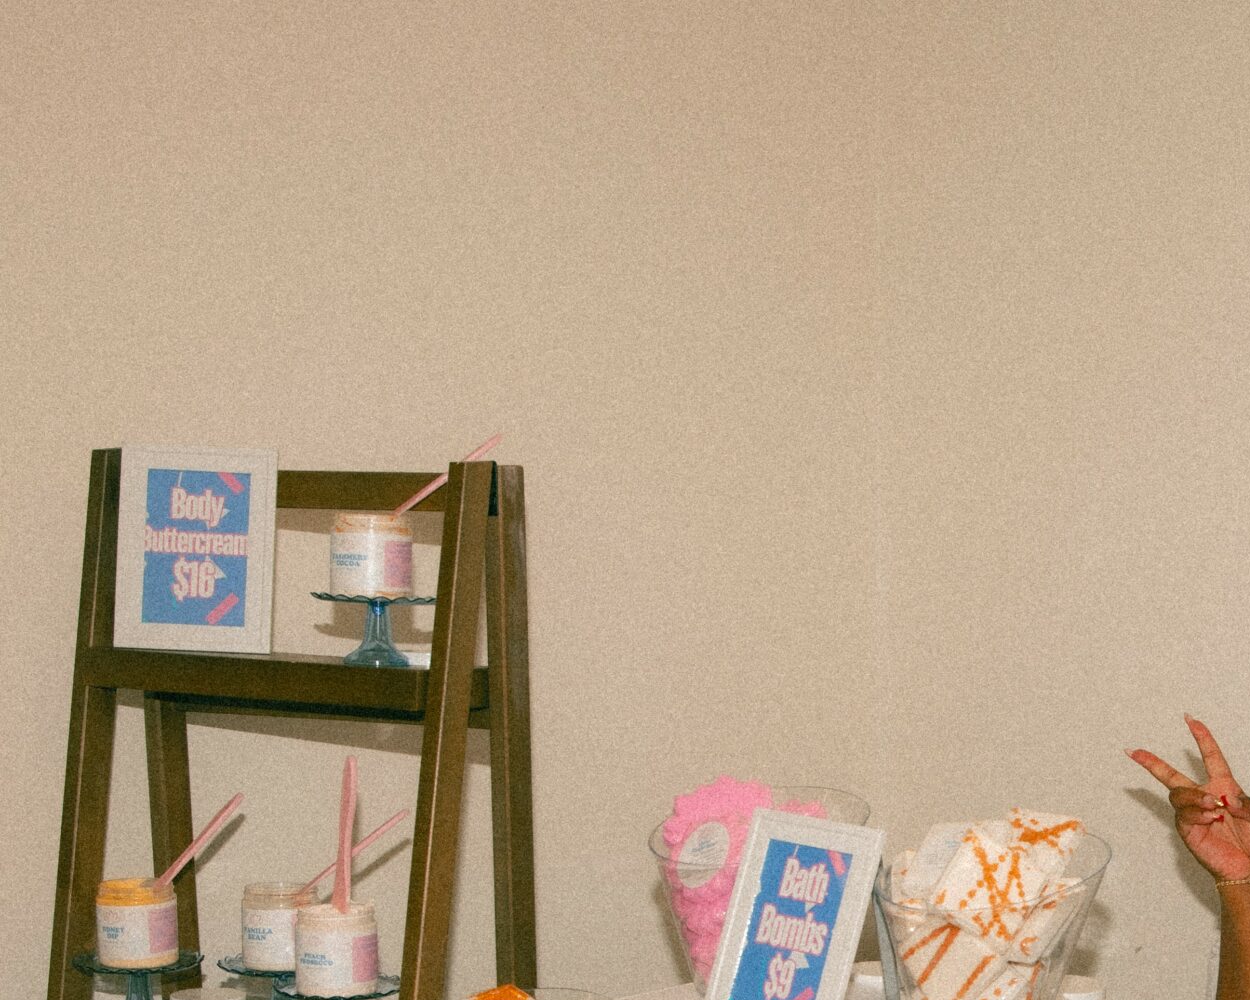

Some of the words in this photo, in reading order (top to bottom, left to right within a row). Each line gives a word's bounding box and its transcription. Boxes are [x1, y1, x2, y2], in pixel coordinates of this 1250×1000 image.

[171, 487, 224, 529] Body
[173, 555, 216, 601] $16
[779, 857, 830, 904] Bath
[755, 902, 829, 957] Bombs
